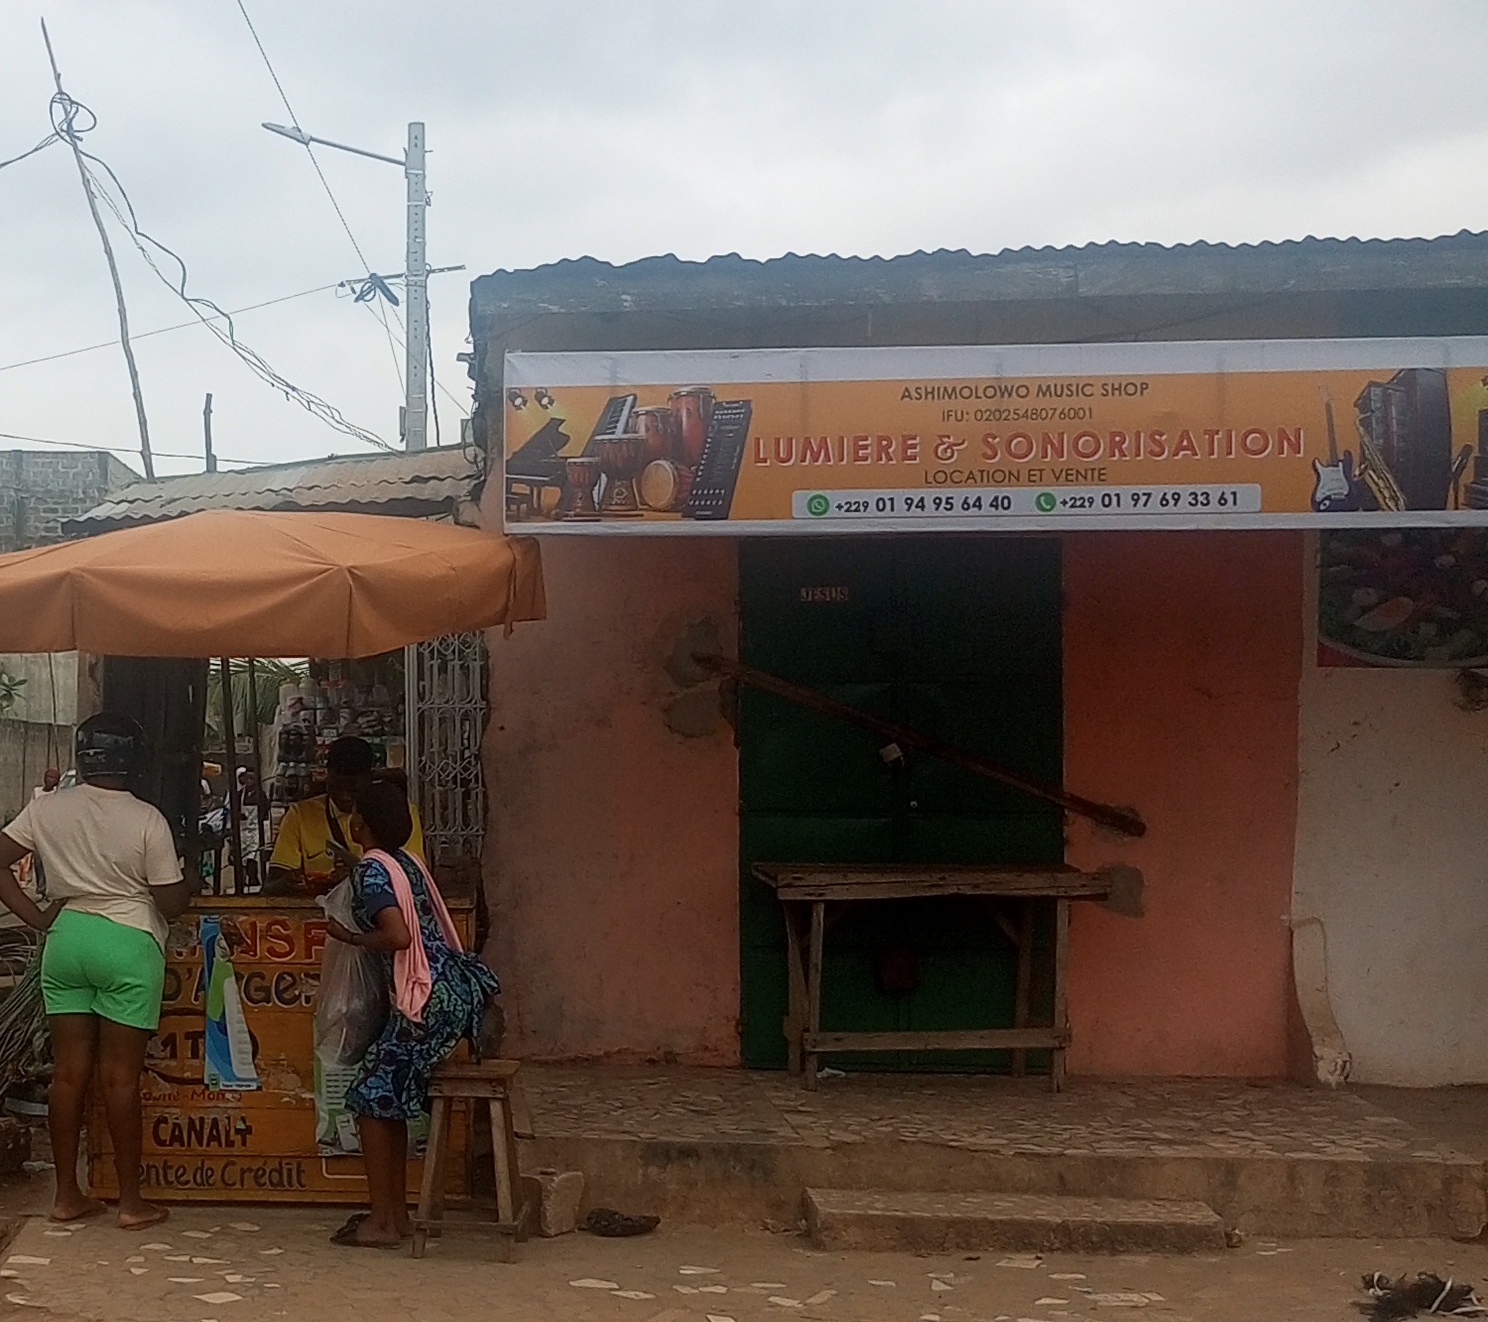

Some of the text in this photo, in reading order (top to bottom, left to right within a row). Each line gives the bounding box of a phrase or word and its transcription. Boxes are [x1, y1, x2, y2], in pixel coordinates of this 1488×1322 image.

[900, 381, 1150, 402] ASHIMOLOWO MUSIC SHOP
[941, 406, 1094, 423] IFU: 0202548076001
[753, 427, 1305, 467] LUMIERE & SONORISATION
[924, 467, 1107, 485] LOCATION ET VENTE
[835, 495, 1012, 514] +229 01 94 95 64 40
[1060, 491, 1238, 509] +229 01 97 69 33 61
[152, 1114, 254, 1149] CANAL+
[192, 1159, 216, 1188] de
